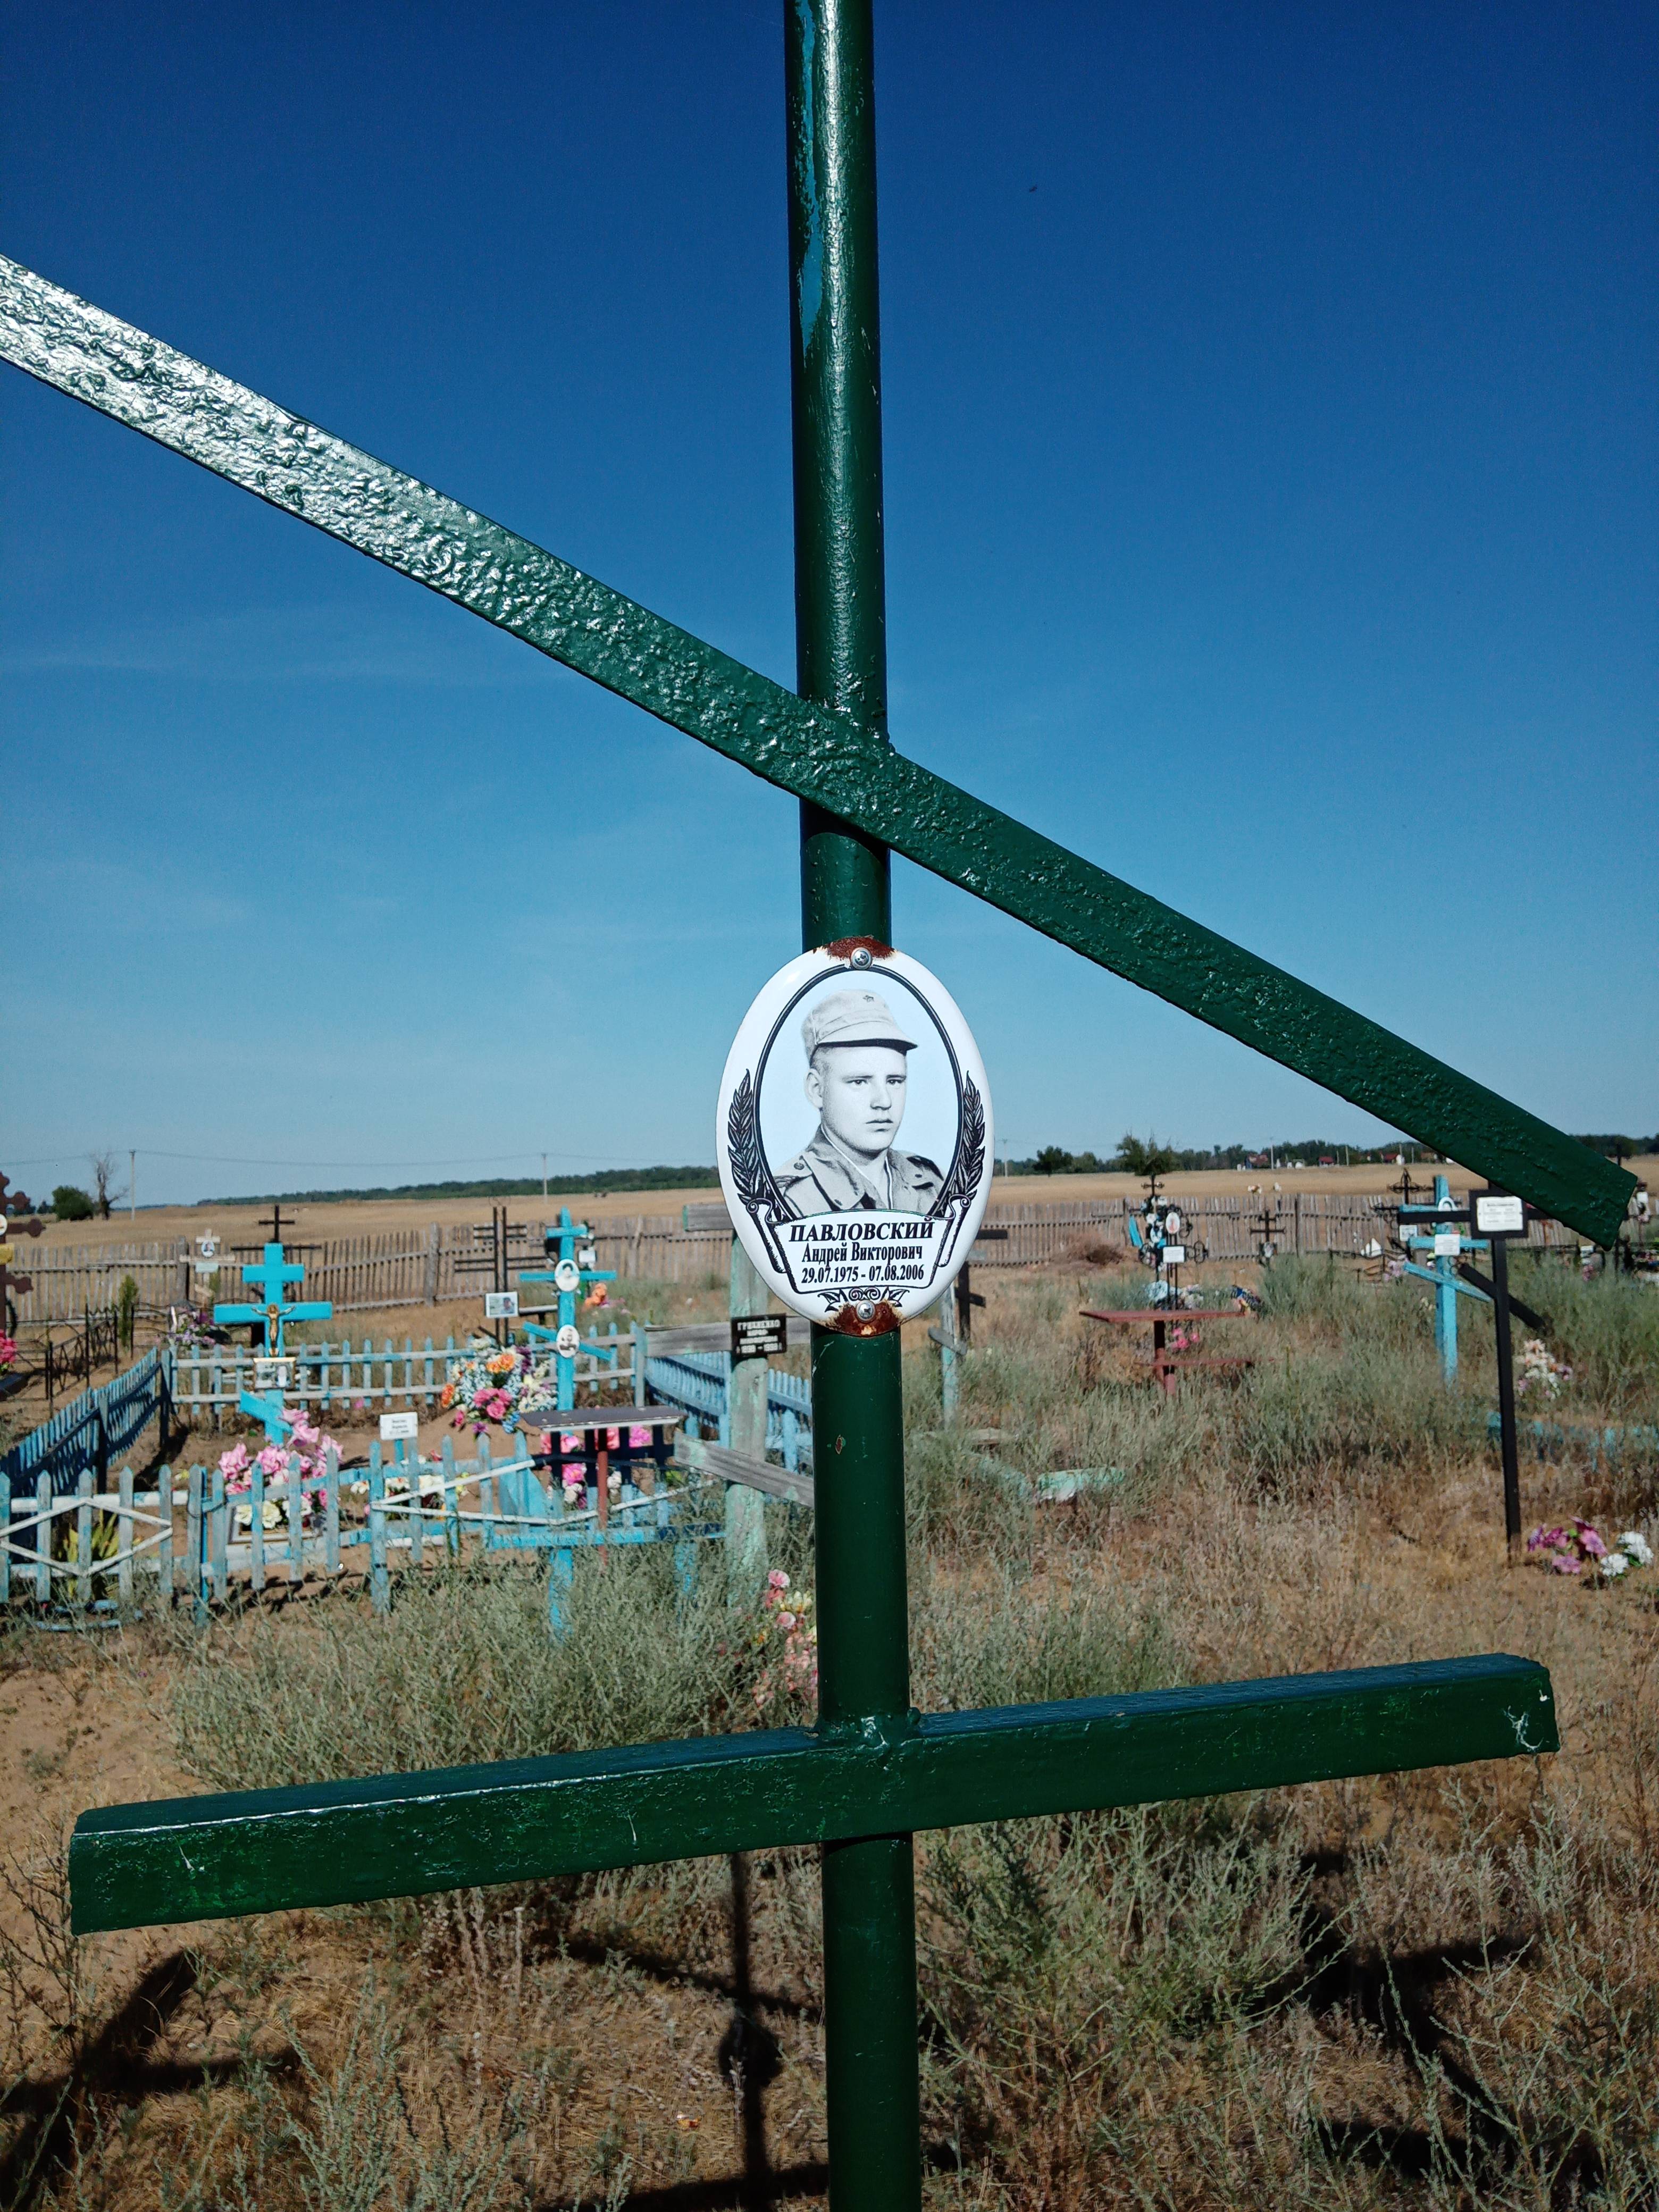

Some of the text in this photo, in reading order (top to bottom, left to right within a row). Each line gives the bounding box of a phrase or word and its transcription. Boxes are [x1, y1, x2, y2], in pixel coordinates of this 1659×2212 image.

[789, 1217, 935, 1242] ПАВЛОВСКИЙ
[801, 1242, 923, 1267] Андрей Викторович
[801, 1266, 859, 1283] 29.07.1975
[868, 1264, 924, 1281] 07.08.2006
